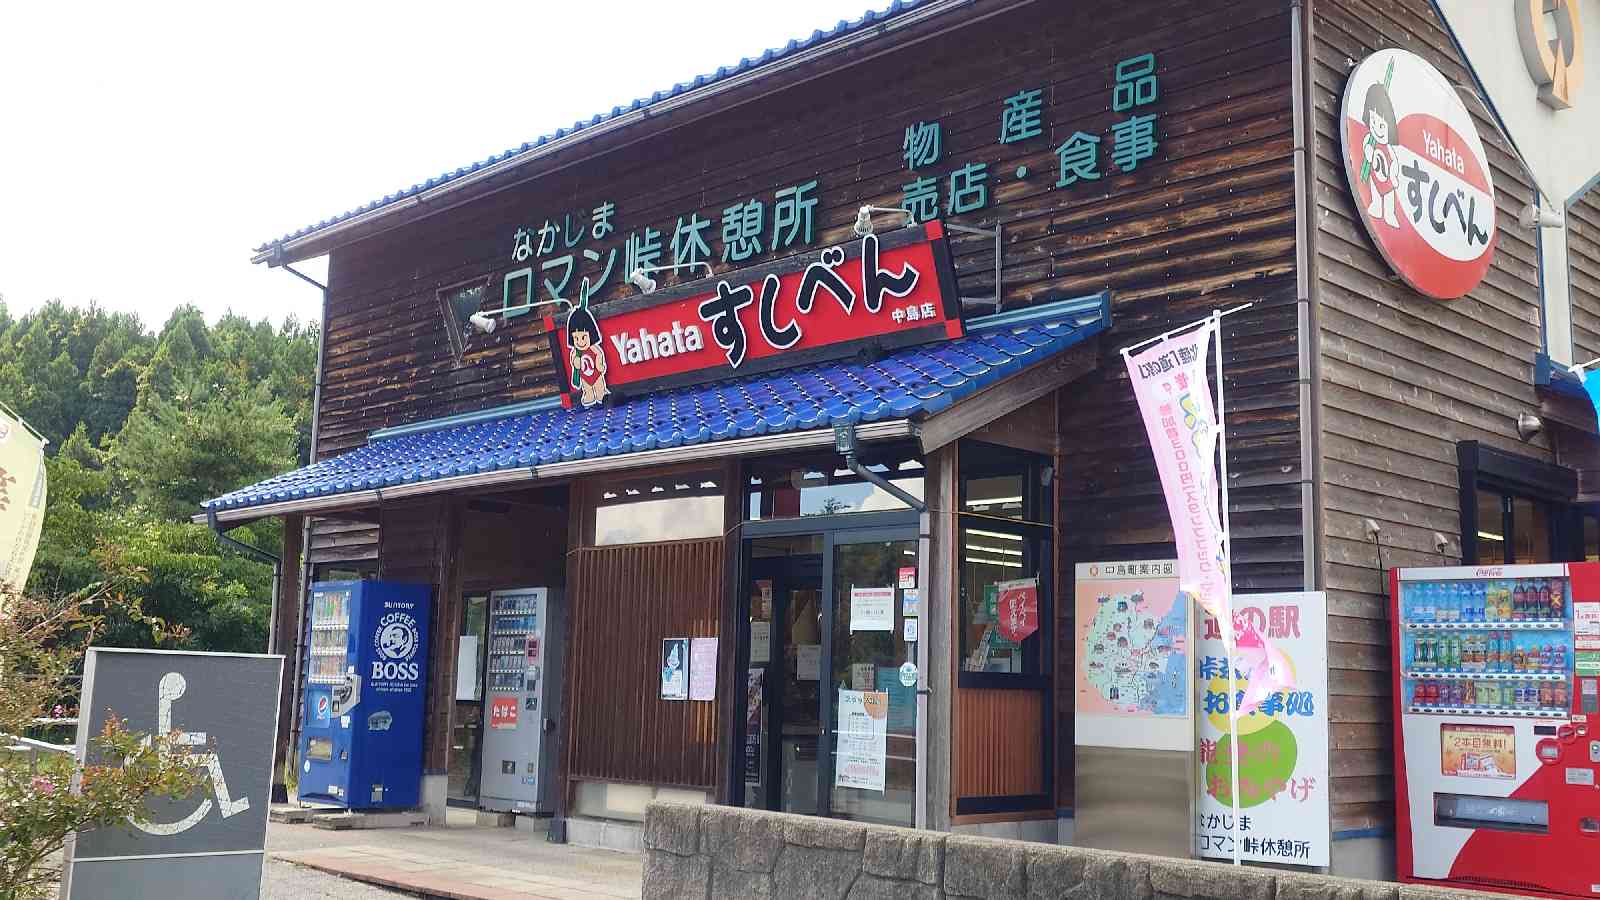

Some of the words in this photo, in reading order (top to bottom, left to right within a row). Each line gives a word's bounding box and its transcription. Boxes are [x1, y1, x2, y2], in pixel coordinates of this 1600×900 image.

[1423, 130, 1465, 175] Yahata
[1401, 159, 1489, 246] すしべん
[502, 180, 819, 318] ロマン峠休憩所
[512, 201, 616, 262] なかじま
[698, 234, 920, 369] すしべん
[891, 303, 937, 324] 中島店
[610, 320, 703, 366] Yahata
[380, 611, 417, 628] COFFEE
[371, 661, 419, 681] BOSS
